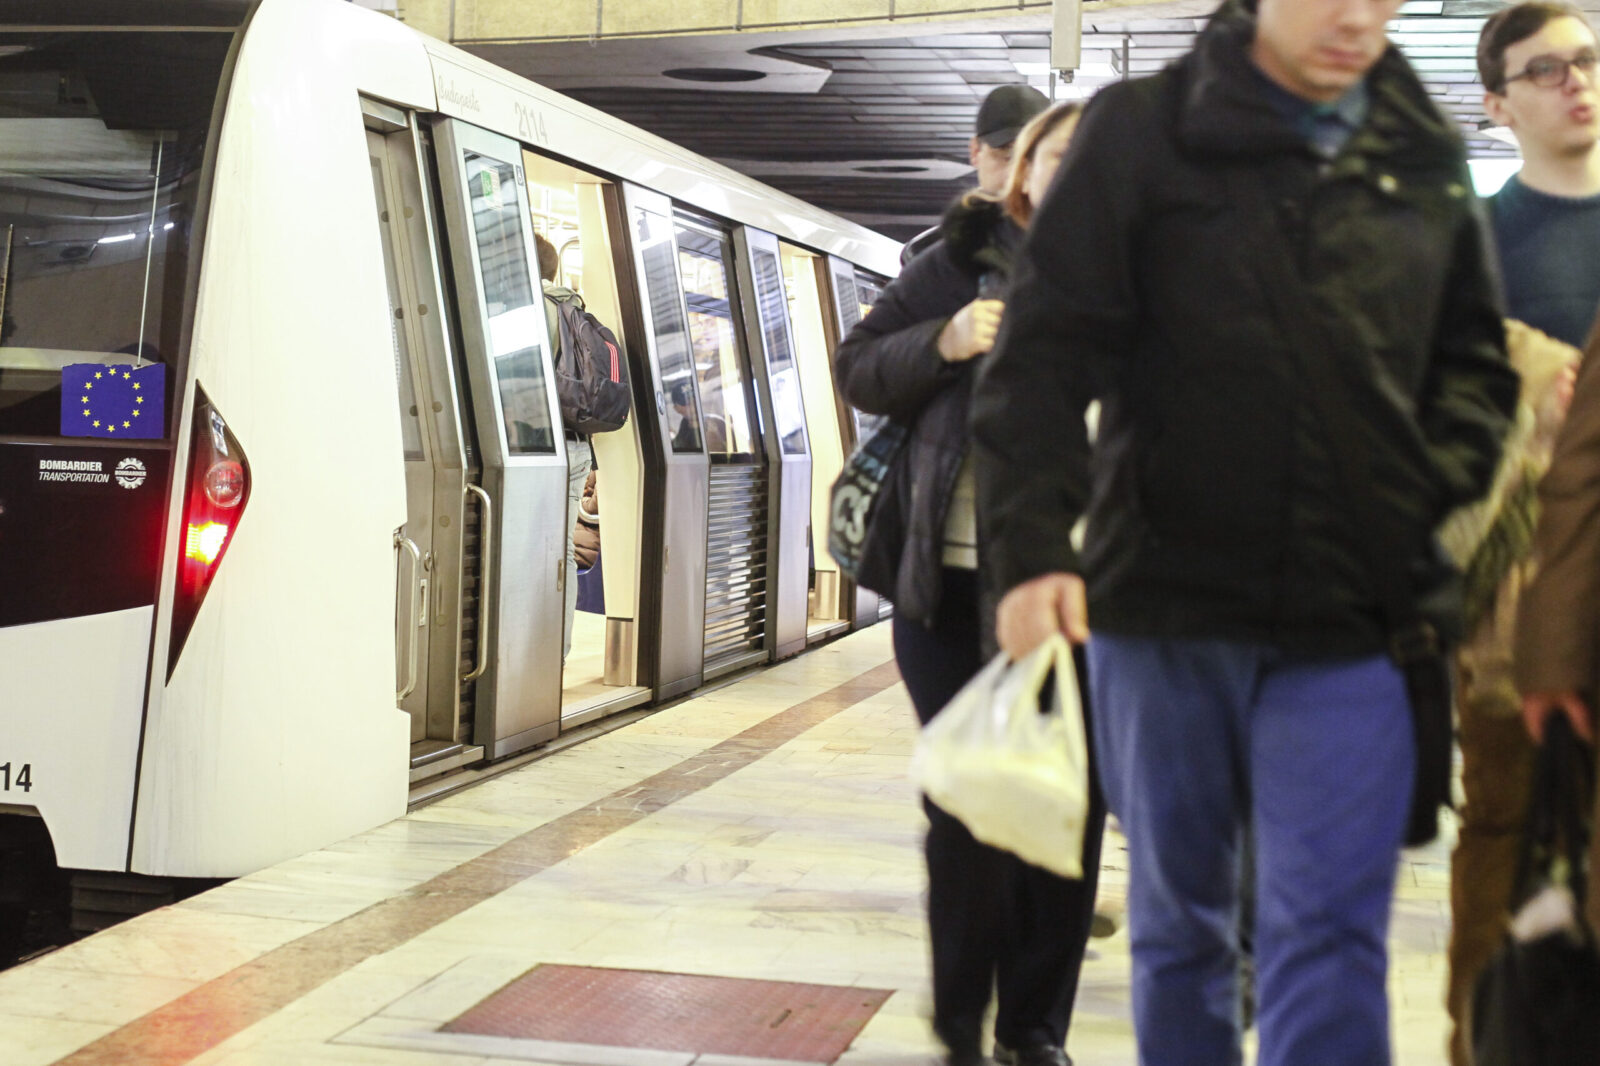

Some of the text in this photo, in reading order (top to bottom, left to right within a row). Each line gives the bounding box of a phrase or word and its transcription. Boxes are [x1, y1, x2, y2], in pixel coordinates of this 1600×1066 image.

[514, 101, 548, 144] 2114
[39, 460, 103, 472] BOMBARDIER
[39, 471, 110, 483] TRANSPORTATION
[0, 761, 32, 792] 14
